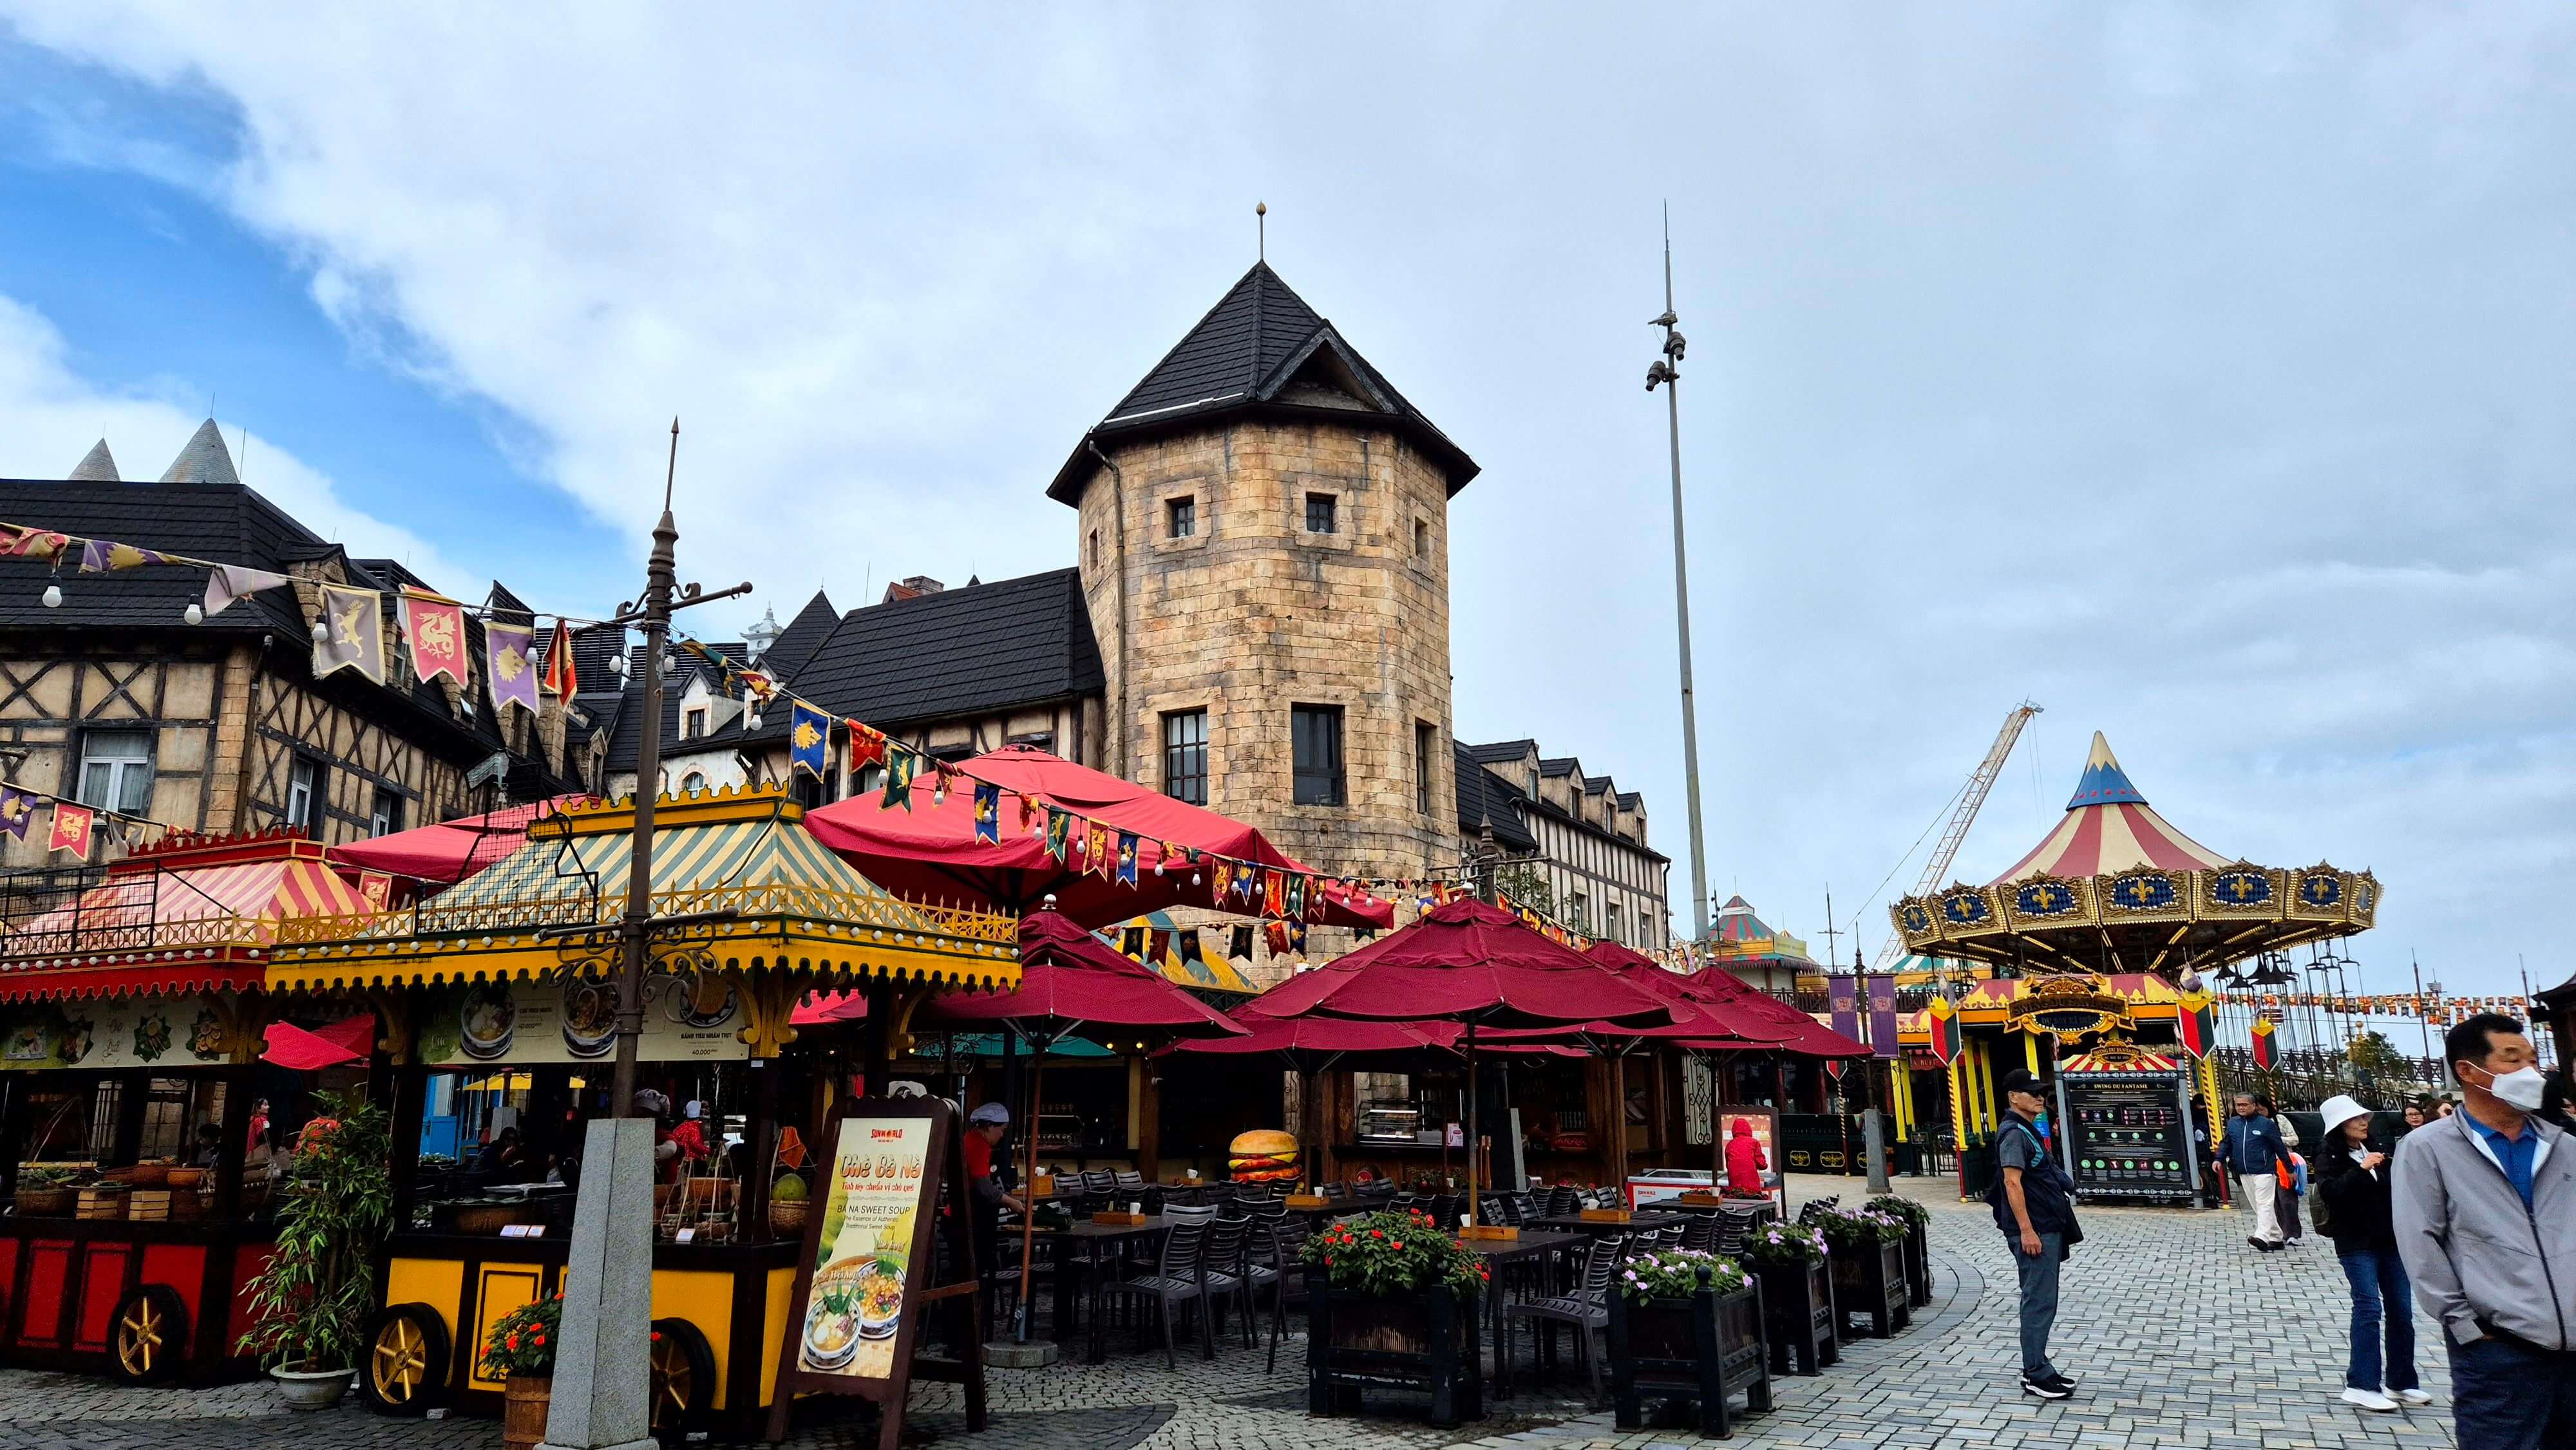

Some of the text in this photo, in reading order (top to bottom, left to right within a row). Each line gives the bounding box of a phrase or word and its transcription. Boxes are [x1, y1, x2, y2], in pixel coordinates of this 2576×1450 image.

[2013, 999, 2048, 1015] SWING
[840, 1153, 922, 1179] Chè Bà Nà
[837, 1205, 911, 1215] BA NA SWEET SOUP
